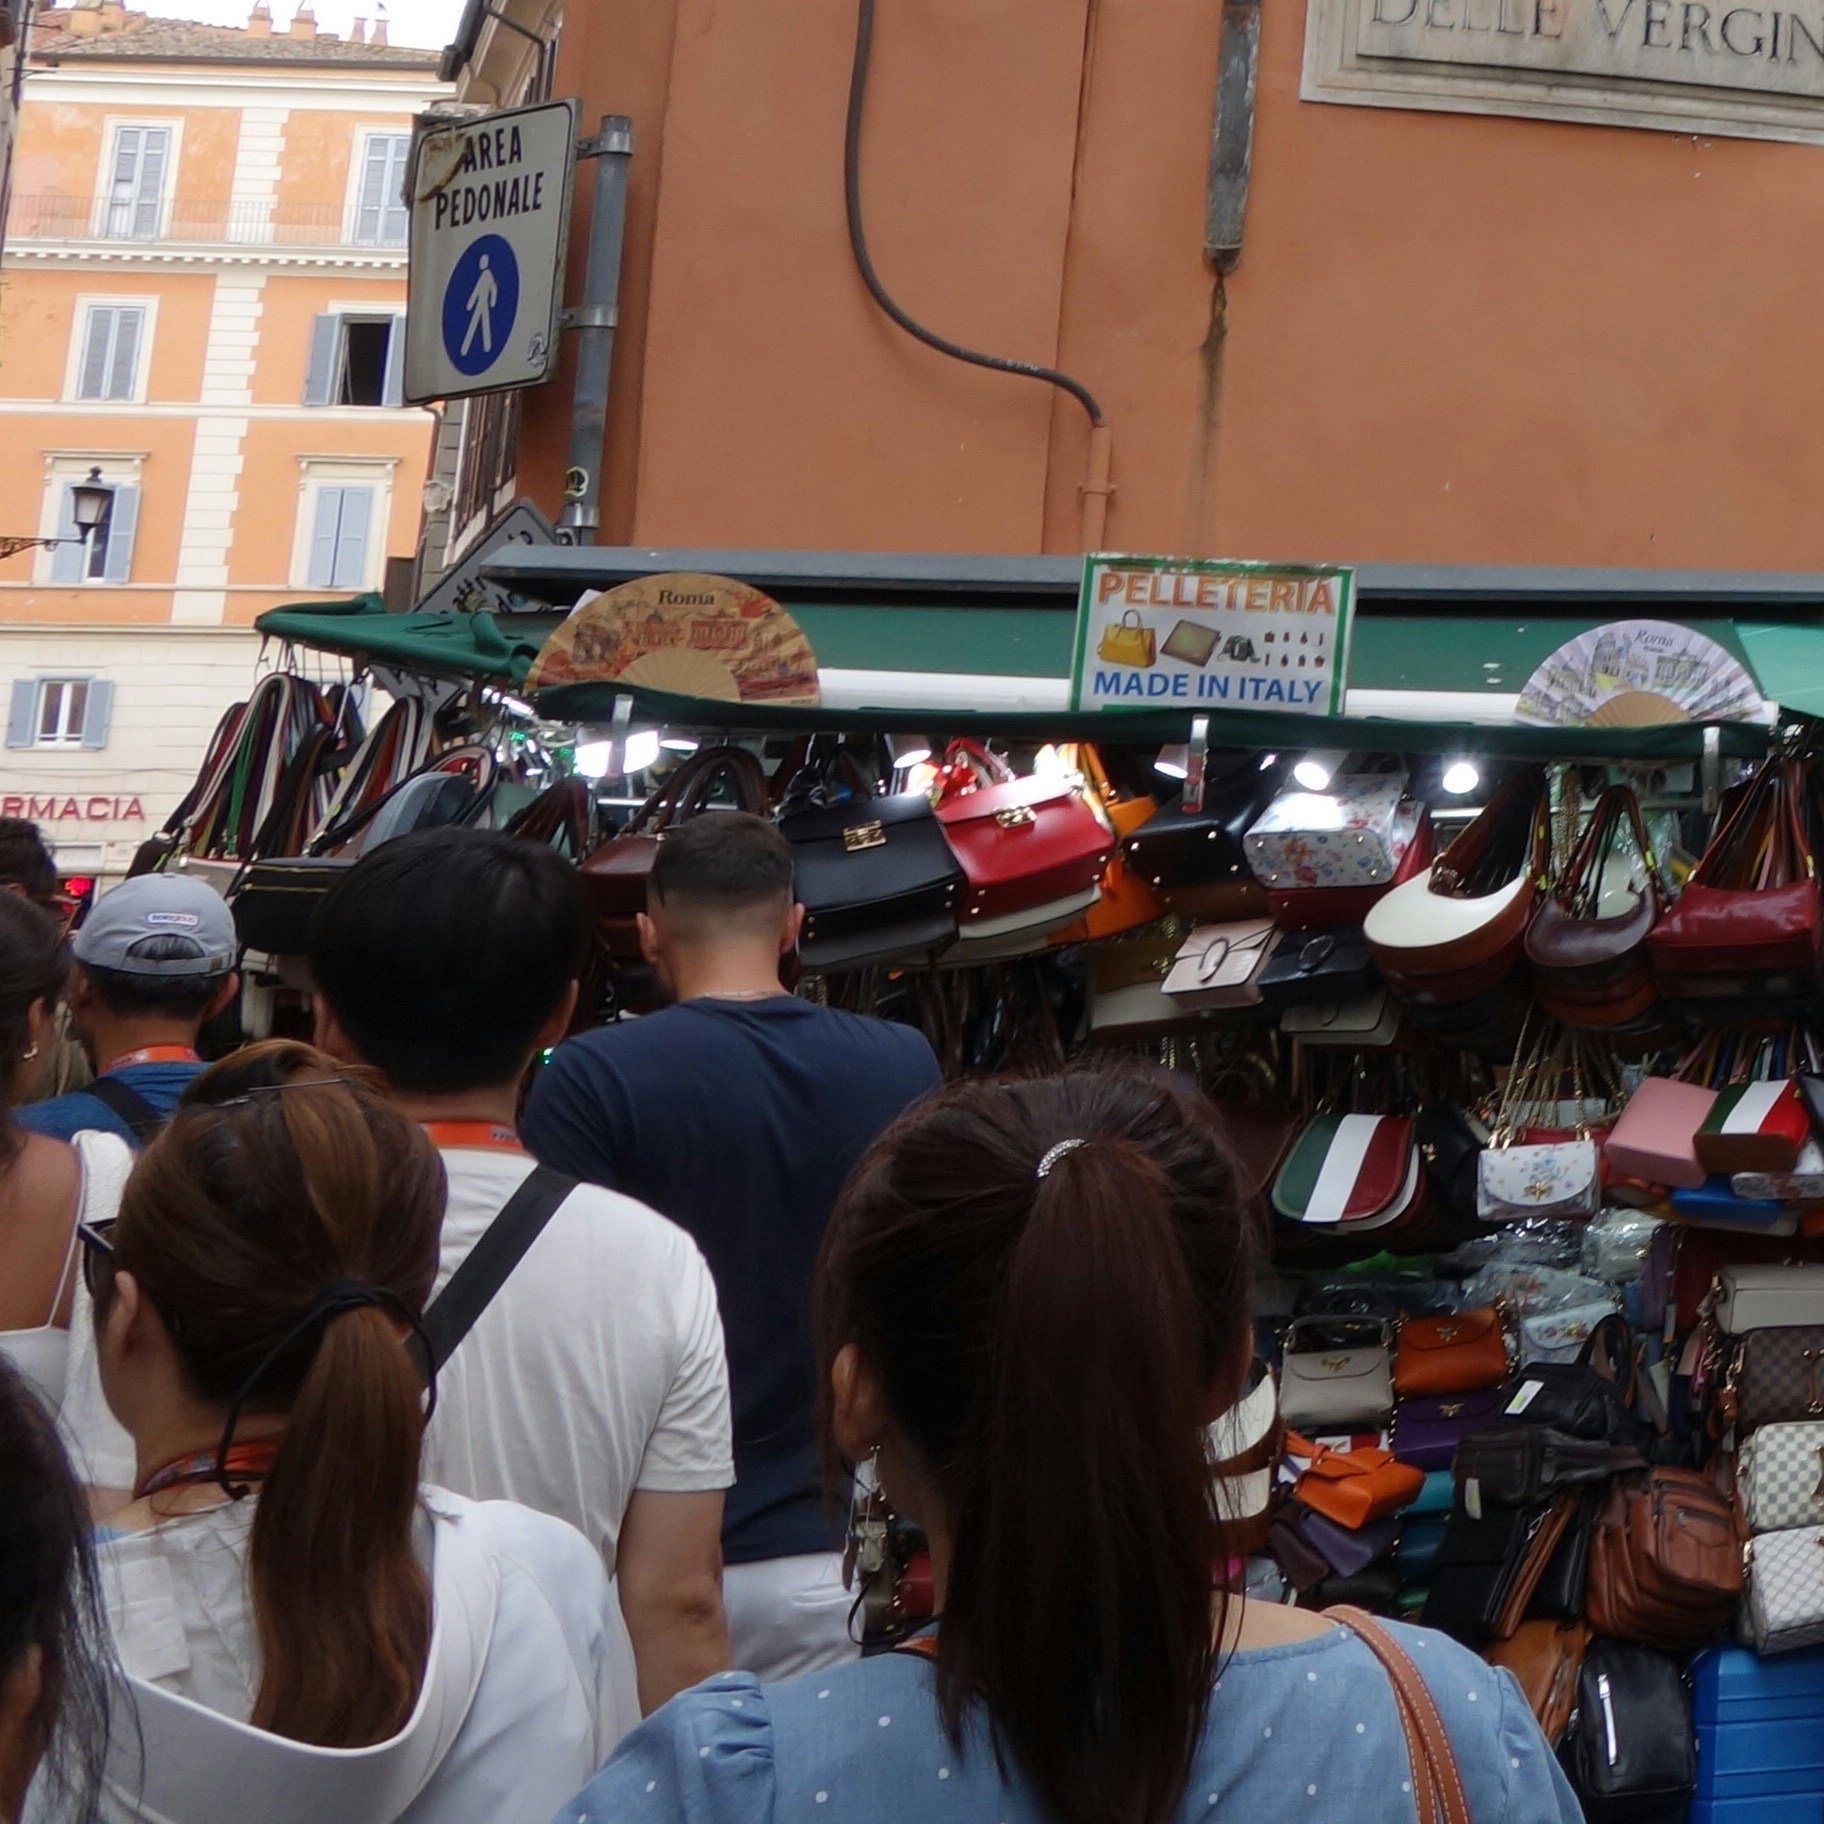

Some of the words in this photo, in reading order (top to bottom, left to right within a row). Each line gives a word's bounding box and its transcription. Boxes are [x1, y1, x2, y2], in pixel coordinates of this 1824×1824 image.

[462, 125, 523, 174] AREA
[434, 171, 545, 231] PEDONALE
[658, 589, 715, 606] Roma
[1097, 571, 1334, 618] PELLETERIA
[1092, 669, 1190, 700] MADE
[1197, 672, 1231, 701] IN
[1237, 676, 1325, 708] ITALY
